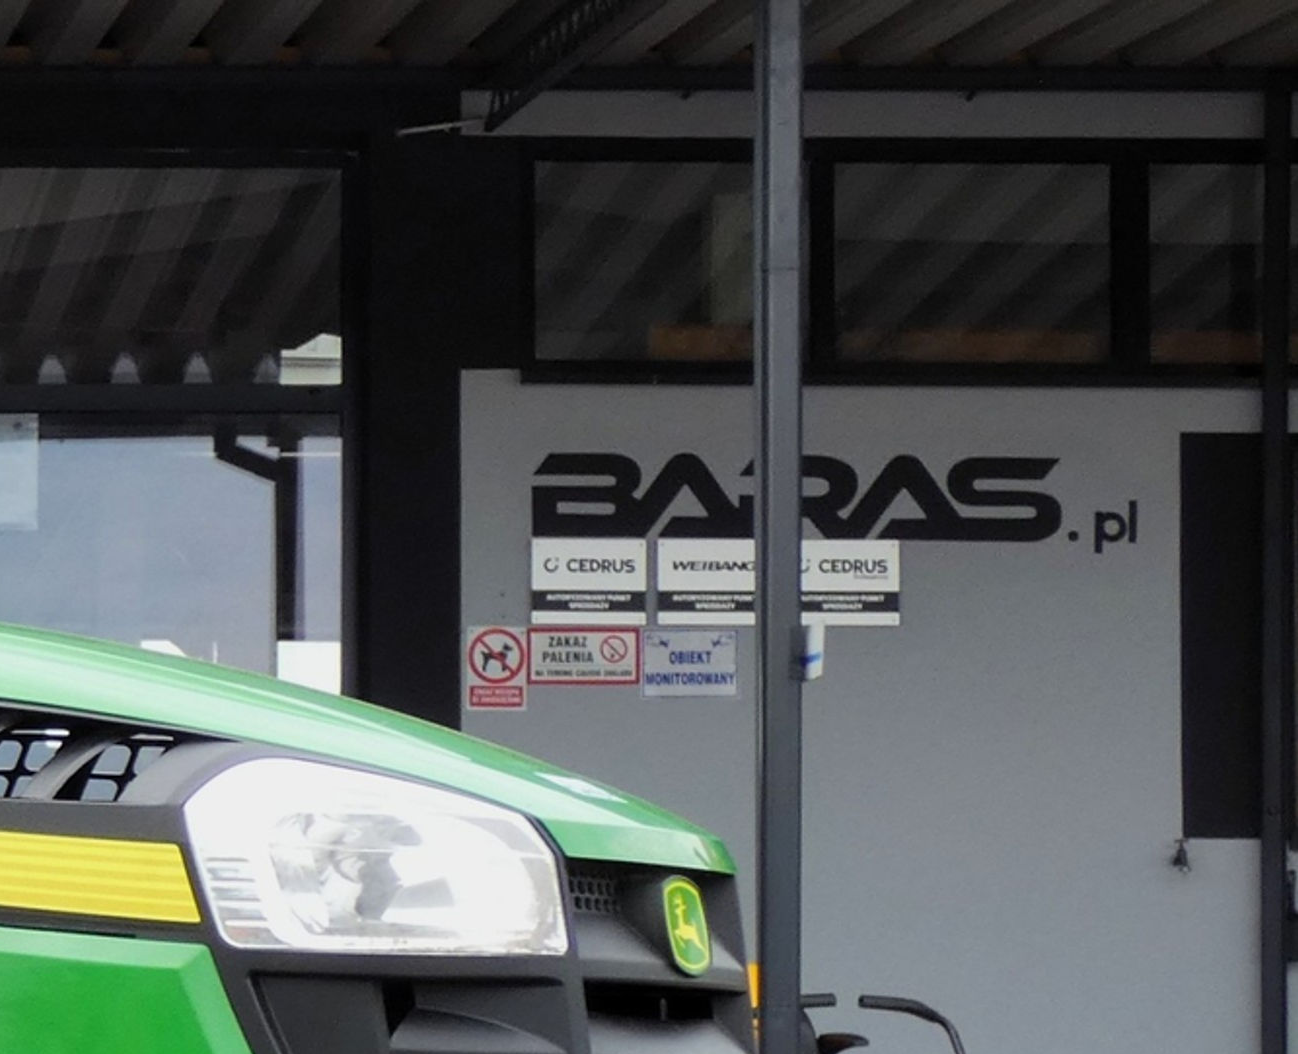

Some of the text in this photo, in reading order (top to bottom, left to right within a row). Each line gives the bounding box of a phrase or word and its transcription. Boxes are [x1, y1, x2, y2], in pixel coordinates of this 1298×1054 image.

[566, 558, 636, 574] CEDRUS
[818, 558, 888, 574] CEDRUS
[548, 635, 588, 648] ZAKAZ
[541, 651, 594, 663] PALENIA
[668, 651, 713, 665] OBIEKT
[645, 671, 736, 686] MONITOROWANY
